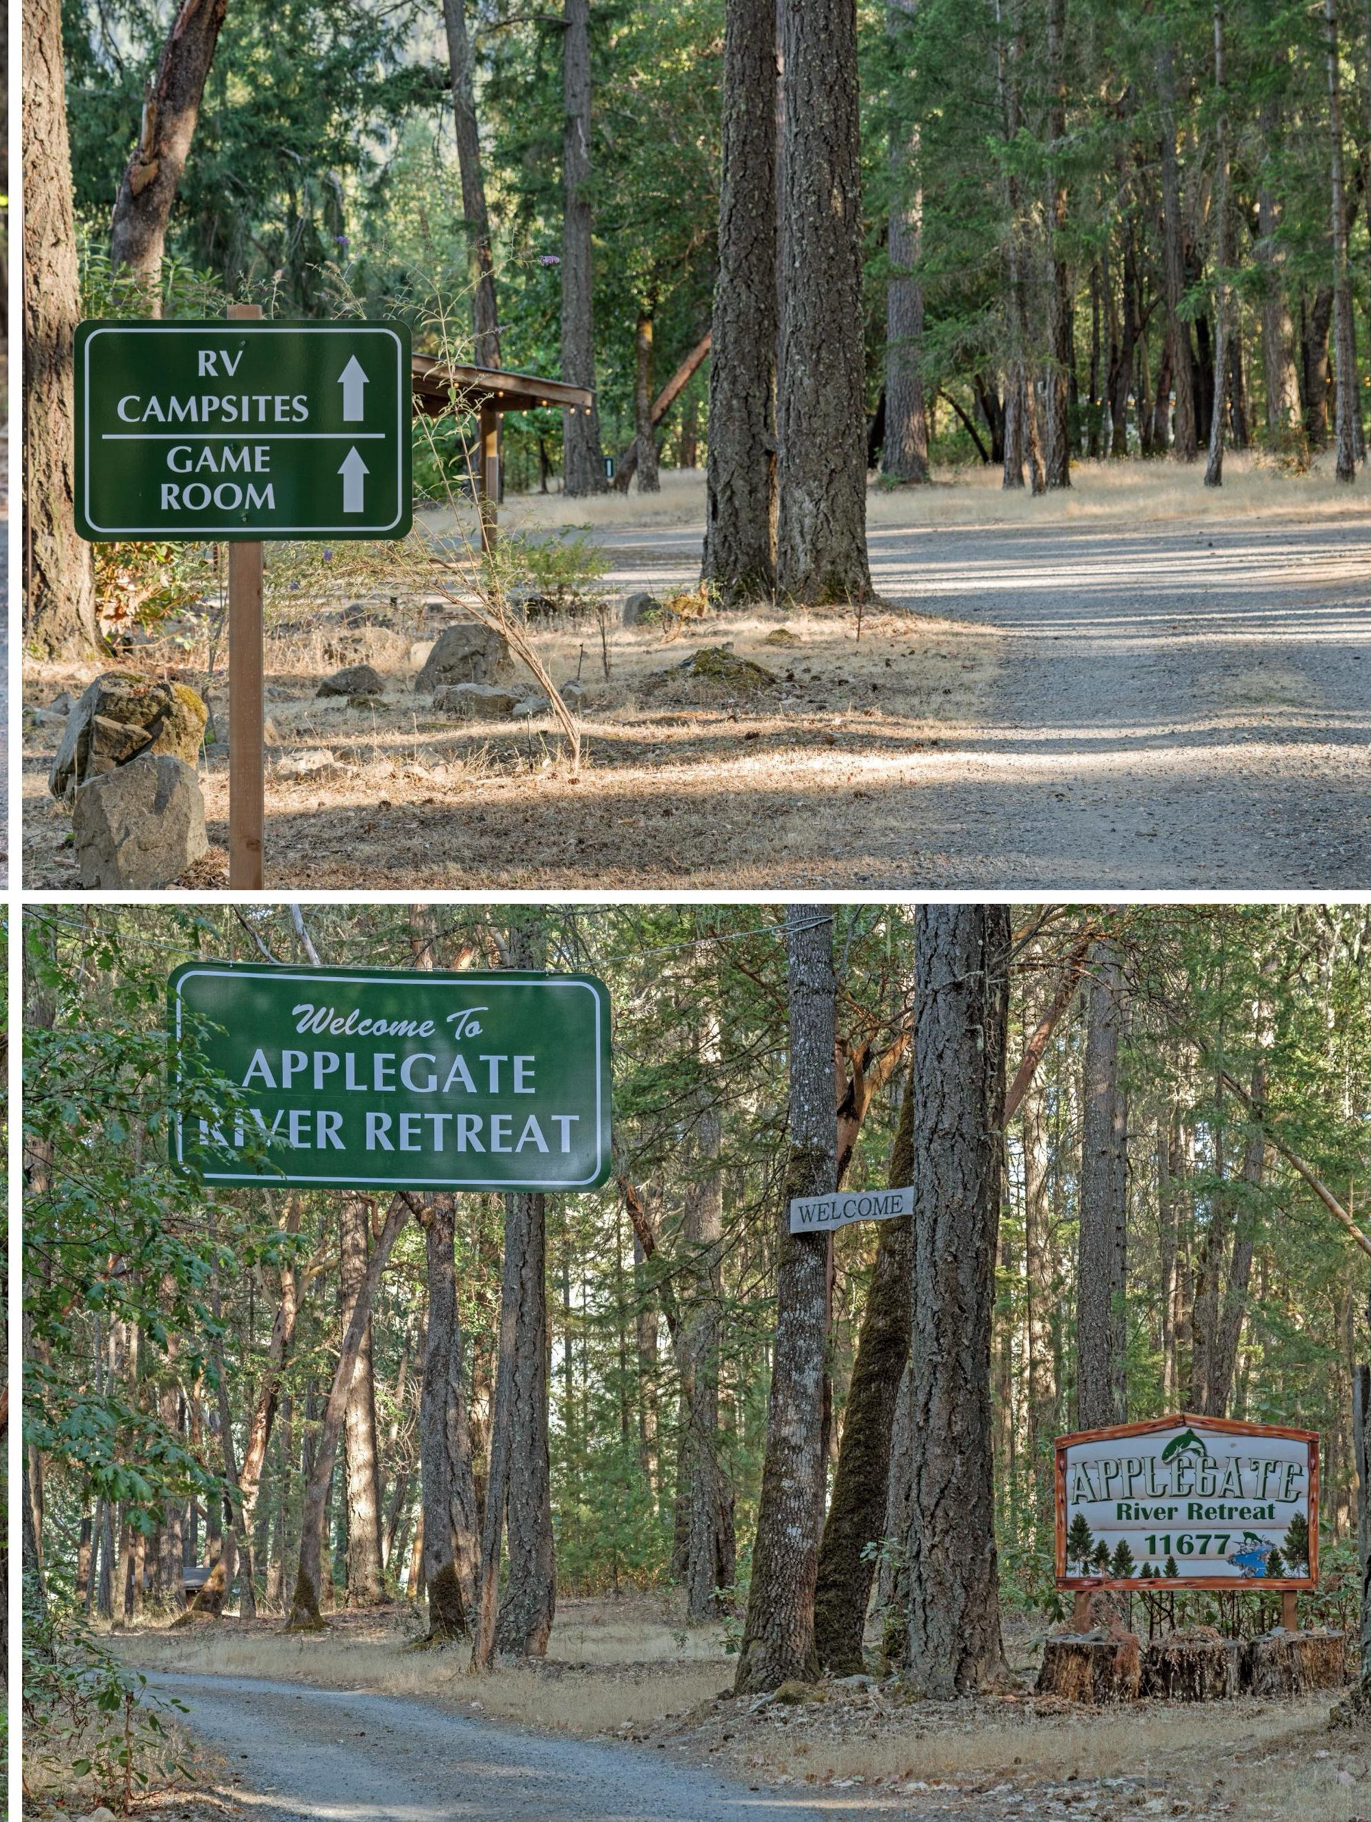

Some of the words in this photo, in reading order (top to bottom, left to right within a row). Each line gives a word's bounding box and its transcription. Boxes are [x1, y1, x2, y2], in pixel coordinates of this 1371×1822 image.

[198, 350, 243, 377] RV
[117, 395, 309, 422] CAMPSITES
[166, 446, 270, 473] GAME
[161, 483, 276, 510] ROOM
[291, 1003, 436, 1039] Welcome
[446, 1006, 489, 1041] To
[241, 1048, 536, 1094] APPLEGATE
[366, 1112, 580, 1153] RETREAT
[798, 1195, 904, 1224] WELCOME
[1071, 1455, 1305, 1506] APPLEGATE
[1116, 1502, 1178, 1521] River
[1187, 1502, 1276, 1521] Retreat
[1144, 1534, 1231, 1555] 11677
